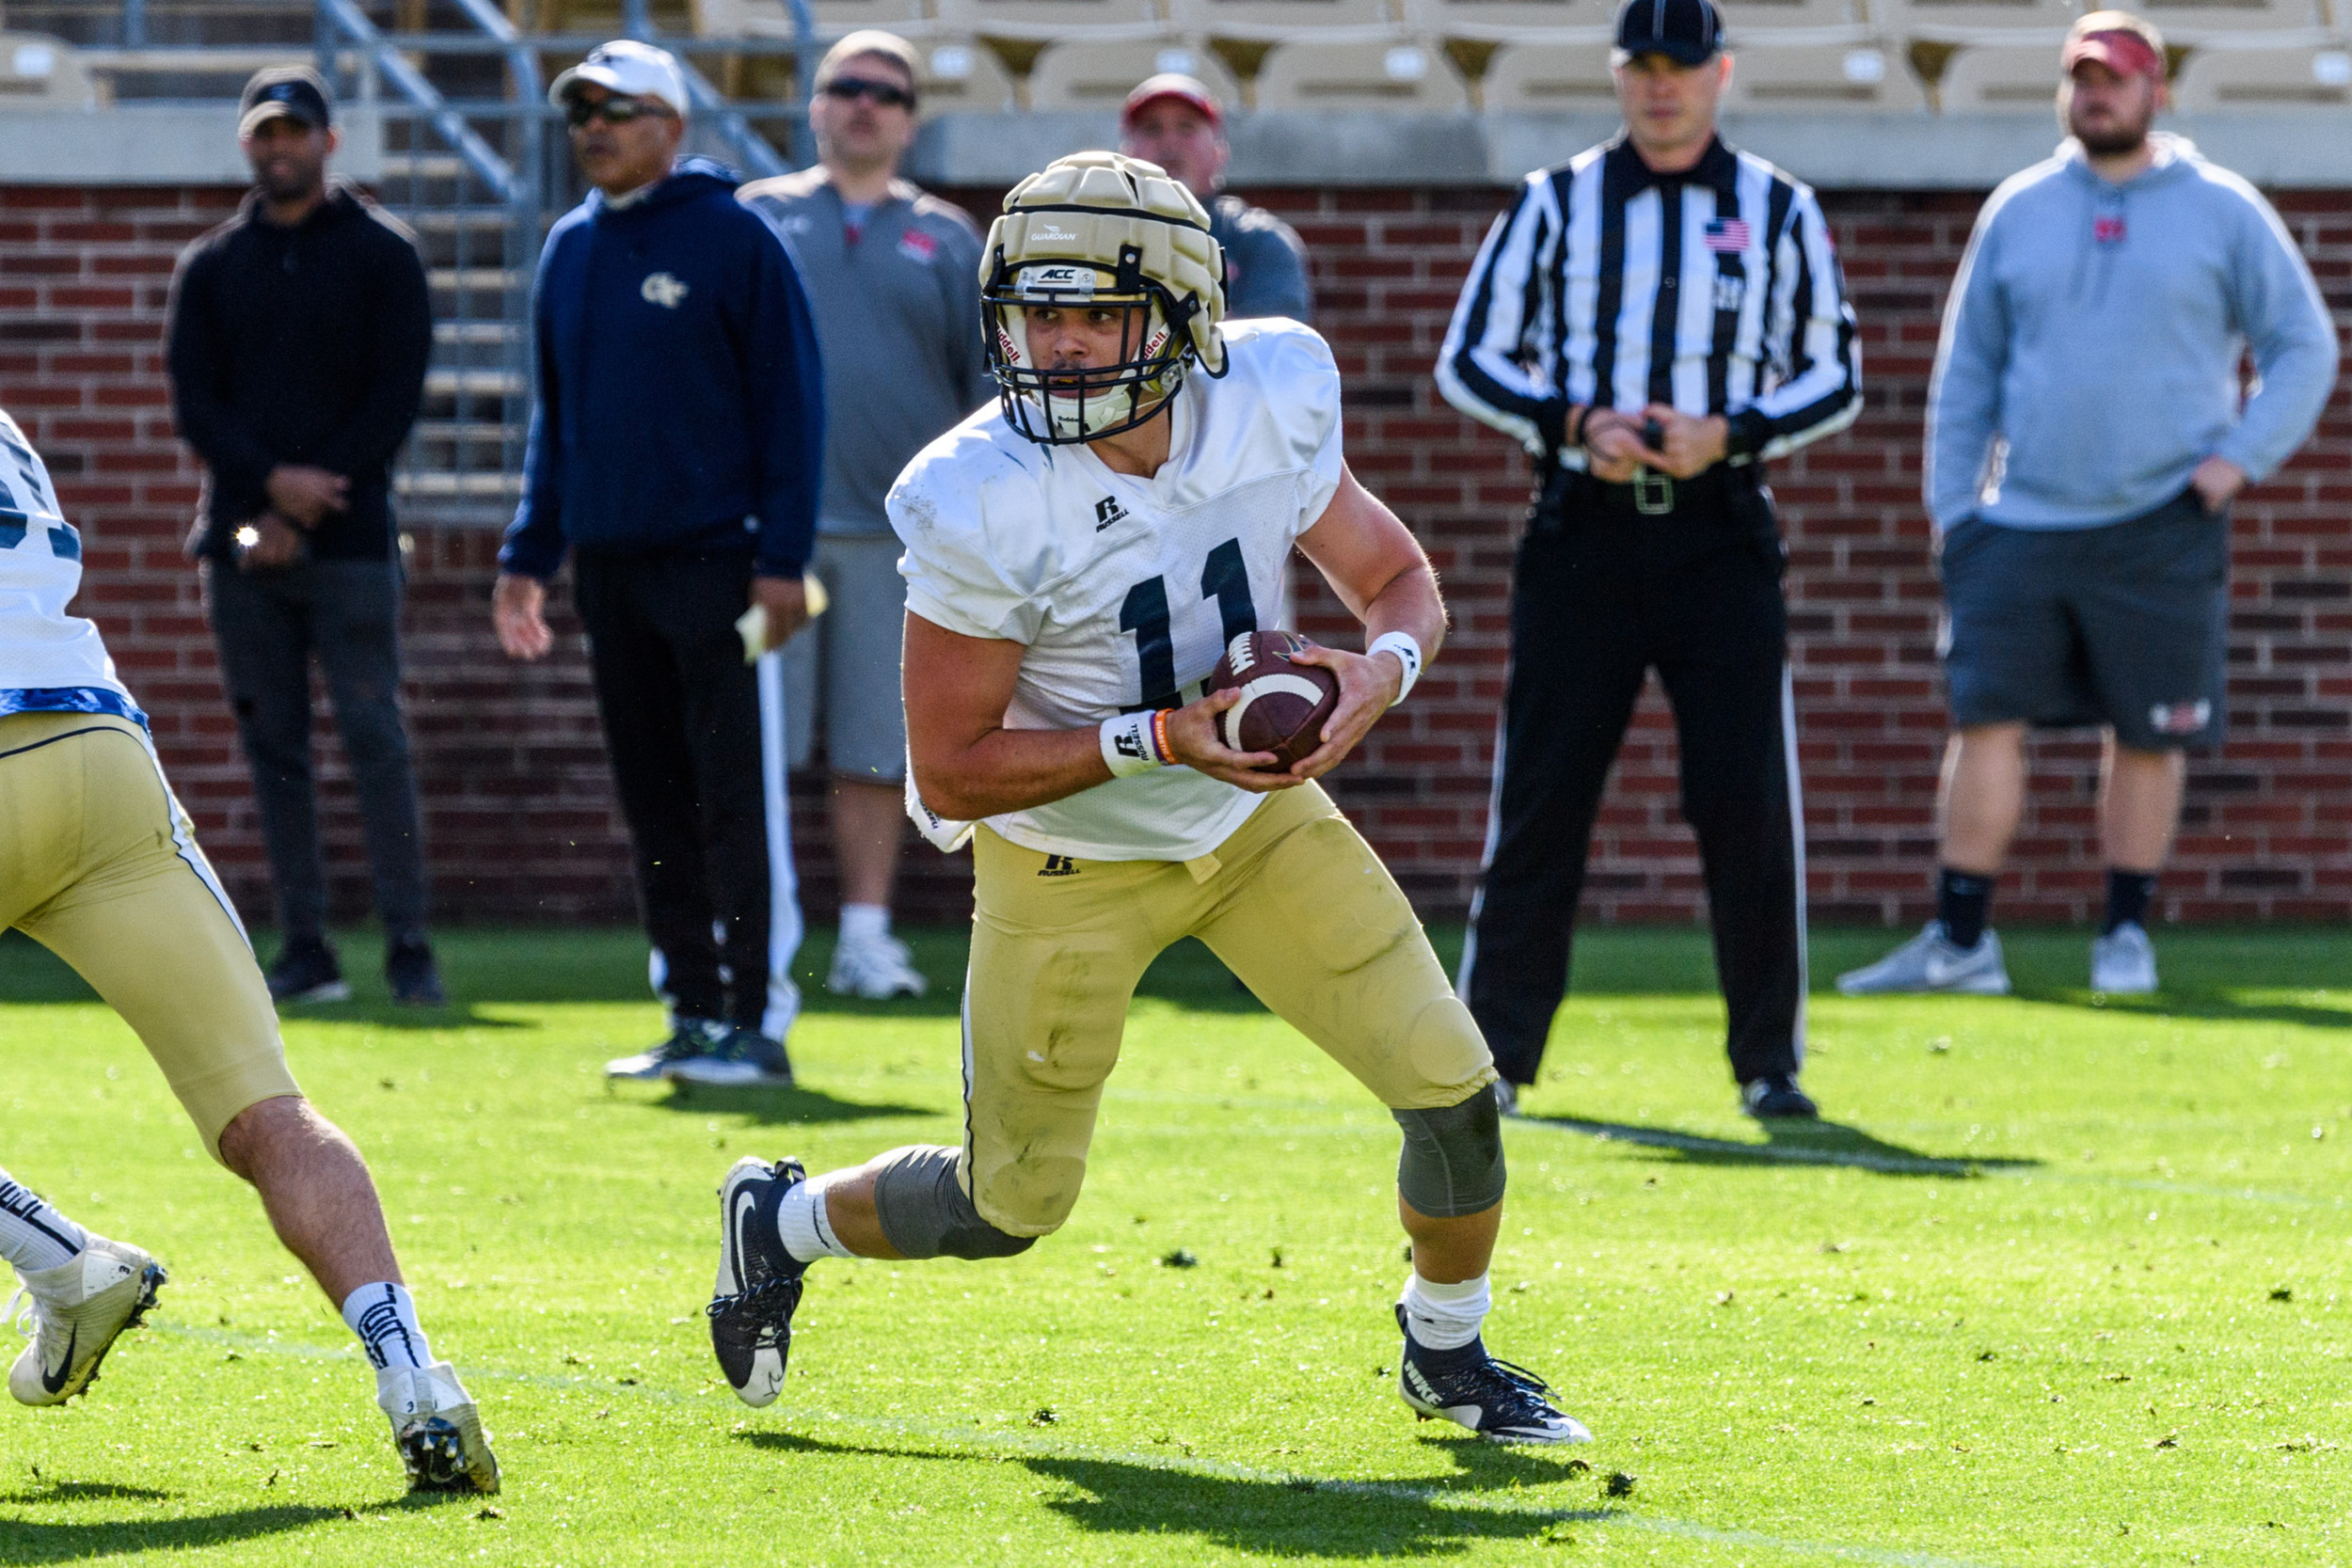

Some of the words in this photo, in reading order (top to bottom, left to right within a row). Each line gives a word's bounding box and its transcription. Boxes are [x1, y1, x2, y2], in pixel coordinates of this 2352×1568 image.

[1040, 269, 1076, 279] ACC
[1096, 508, 1130, 533] RUSSELL
[1119, 537, 1258, 716] 11
[1130, 723, 1150, 761] RUSSELL
[1156, 721, 1170, 755] DIABETIC
[1404, 1359, 1443, 1408] NIKE
